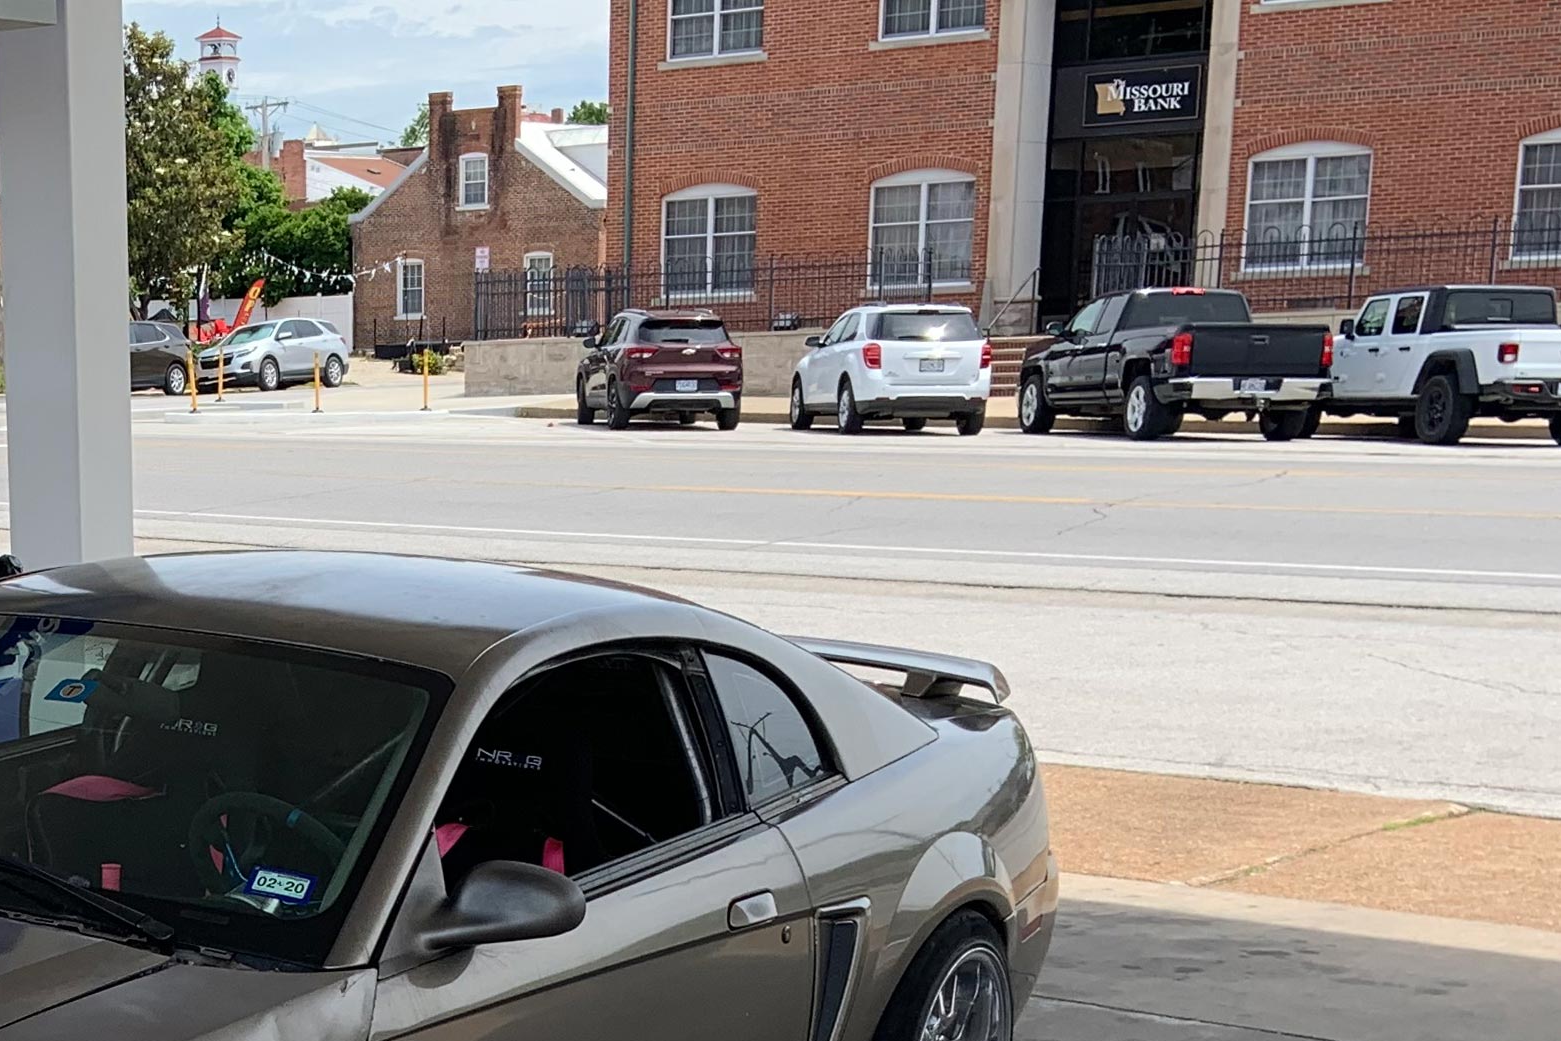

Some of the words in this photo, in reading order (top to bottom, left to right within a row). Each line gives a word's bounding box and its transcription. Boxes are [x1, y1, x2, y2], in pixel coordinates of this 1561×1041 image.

[1107, 81, 1190, 102] MISSOURI
[1132, 96, 1182, 112] BANK
[256, 876, 277, 888] 02
[284, 881, 305, 893] 20
